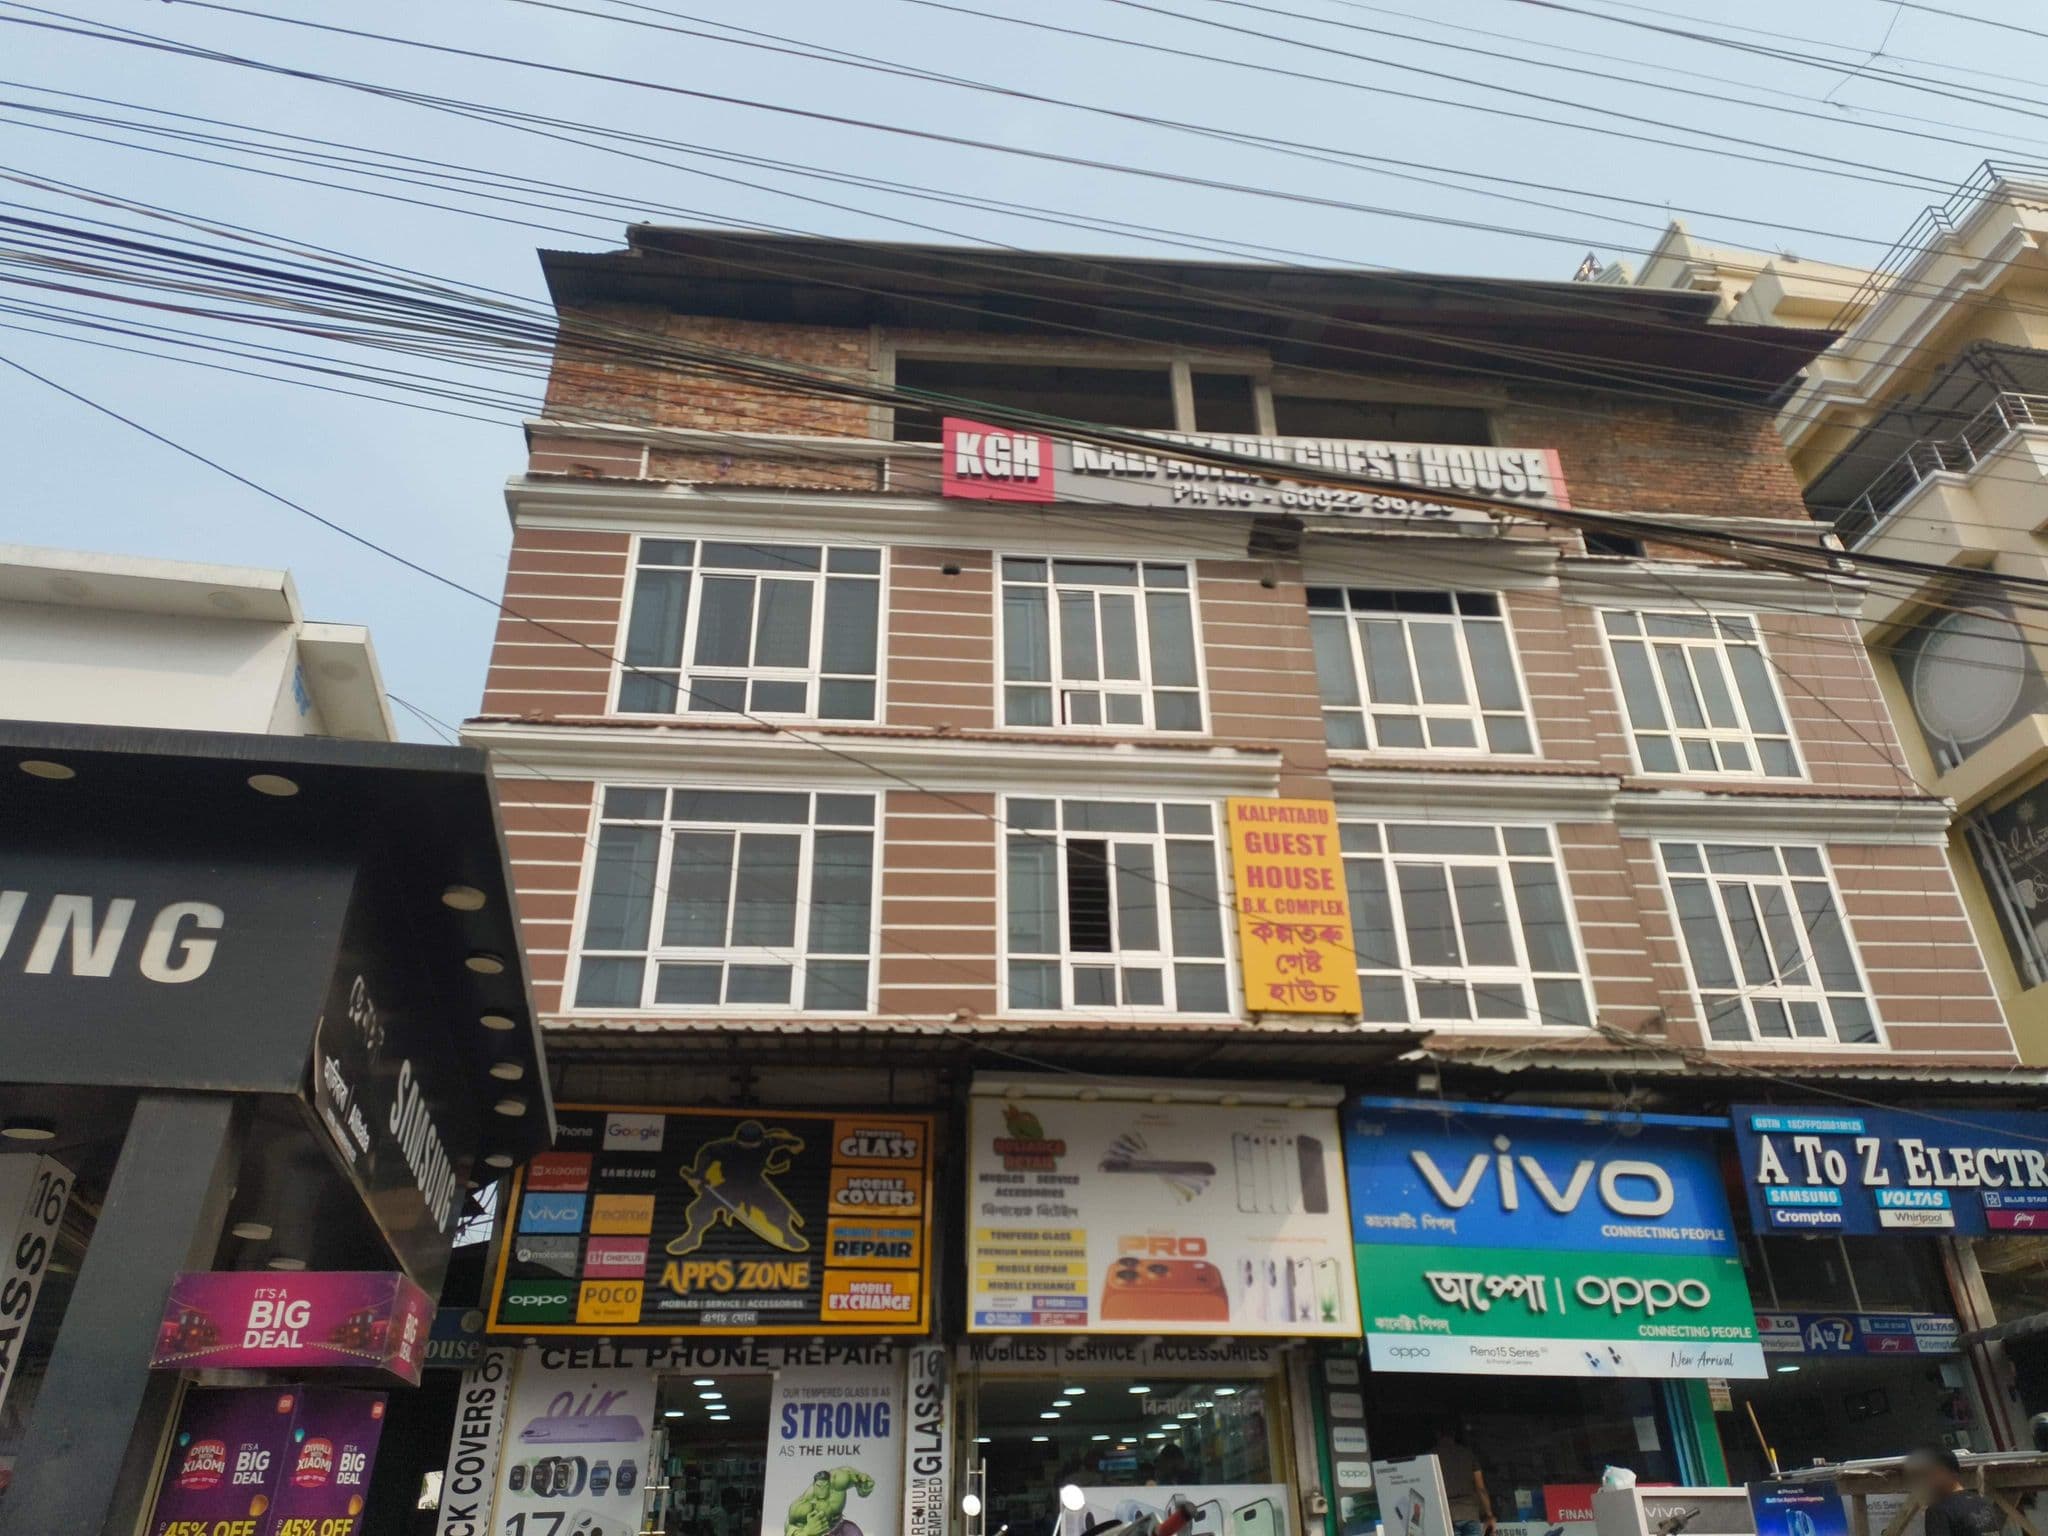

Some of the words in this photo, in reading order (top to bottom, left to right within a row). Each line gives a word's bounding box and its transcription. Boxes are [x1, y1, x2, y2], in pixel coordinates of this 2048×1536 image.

[954, 430, 1040, 480] KGH
[1421, 447, 1547, 496] HOUSE
[1218, 485, 1254, 506] No
[1237, 804, 1329, 825] KALPATARU
[1244, 832, 1328, 857] GUEST
[1246, 865, 1336, 891] HOUSE
[1275, 898, 1345, 916] COMPLEX
[555, 1123, 593, 1137] Phone
[607, 1123, 661, 1142] Google
[389, 1058, 457, 1235] SAMSUNG
[840, 1137, 918, 1158] GLASS
[1757, 1135, 1790, 1184] A
[1855, 1137, 1890, 1186] Z
[544, 1165, 588, 1177] xiaomi
[601, 1168, 657, 1179] SAMSUNG
[1410, 1134, 1675, 1217] vivo
[847, 1178, 905, 1190] MOBILE
[29, 1170, 67, 1227] 16
[837, 1189, 916, 1206] COVERS
[1770, 1190, 1838, 1204] SAMSUNG
[1881, 1191, 1944, 1206] VOLTAS
[528, 1208, 578, 1221] vivo
[1776, 1210, 1842, 1225] Crompton
[1895, 1212, 1943, 1224] Whirlpool
[1602, 1225, 1681, 1241] CONNECTING
[1681, 1227, 1726, 1242] PEOPLE
[833, 1241, 913, 1257] REPAIR
[1118, 1236, 1207, 1258] PRO
[659, 1259, 735, 1295] APPS
[737, 1261, 810, 1291] ZONE
[254, 1288, 277, 1299] IT'S
[278, 1288, 288, 1299] A
[508, 1295, 569, 1307] oppo
[585, 1287, 638, 1304] POCO
[850, 1282, 893, 1294] MOBILE
[1575, 1275, 1712, 1317] oppo
[660, 1300, 699, 1310] MOBILES
[705, 1300, 741, 1310] SERVICE
[747, 1300, 804, 1310] ACCESSORIES
[828, 1294, 912, 1310] EXCHANGE
[0, 1231, 47, 1394] ASS
[247, 1300, 312, 1330] BIG
[403, 1312, 417, 1345] BIG
[1638, 1324, 1709, 1338] CONNECTING
[1711, 1326, 1752, 1339] PEOPLE
[1776, 1320, 1795, 1329] LG
[1915, 1322, 1955, 1331] VOLTAS
[242, 1330, 304, 1349] DEAL
[1810, 1323, 1828, 1350] A
[1824, 1327, 1836, 1342] to
[1833, 1324, 1851, 1350] Z
[424, 1337, 481, 1361] ouse
[541, 1346, 633, 1370] CELL
[646, 1345, 770, 1368] PHONE
[783, 1342, 893, 1366] REPAIR
[969, 1344, 1048, 1362] MOBILES
[1064, 1344, 1136, 1361] SERVICE
[1153, 1344, 1270, 1361] ACCESSORIES
[1389, 1346, 1431, 1359] oppo
[1470, 1345, 1507, 1358] Reno15
[1508, 1346, 1541, 1358] Series
[1670, 1352, 1695, 1369] New
[1698, 1352, 1735, 1368] Arrival
[545, 1383, 630, 1418] air
[783, 1388, 799, 1398] OUR
[802, 1388, 843, 1398] TEMPERED
[845, 1388, 869, 1398] GLASS
[880, 1387, 891, 1398] AS
[781, 1402, 891, 1440] STRONG
[913, 1382, 944, 1477] GLASS
[453, 1387, 497, 1496] COVERS
[779, 1445, 796, 1457] AS
[799, 1444, 824, 1457] THE
[827, 1444, 861, 1457] HULK
[190, 1447, 224, 1456] DIWALI
[235, 1451, 271, 1472] BIG
[339, 1453, 366, 1473] BIG
[182, 1458, 226, 1474] XIAOMI
[232, 1472, 265, 1485] DEAL
[297, 1457, 332, 1473] XIAOMI
[336, 1472, 361, 1485] DEAL
[1341, 1469, 1369, 1480] oppo
[1558, 1509, 1594, 1521] FINAN
[1645, 1506, 1688, 1519] vivo
[165, 1521, 209, 1536] 45%
[213, 1520, 257, 1536] OFF
[281, 1519, 318, 1536] 45%
[320, 1518, 354, 1536] OFF
